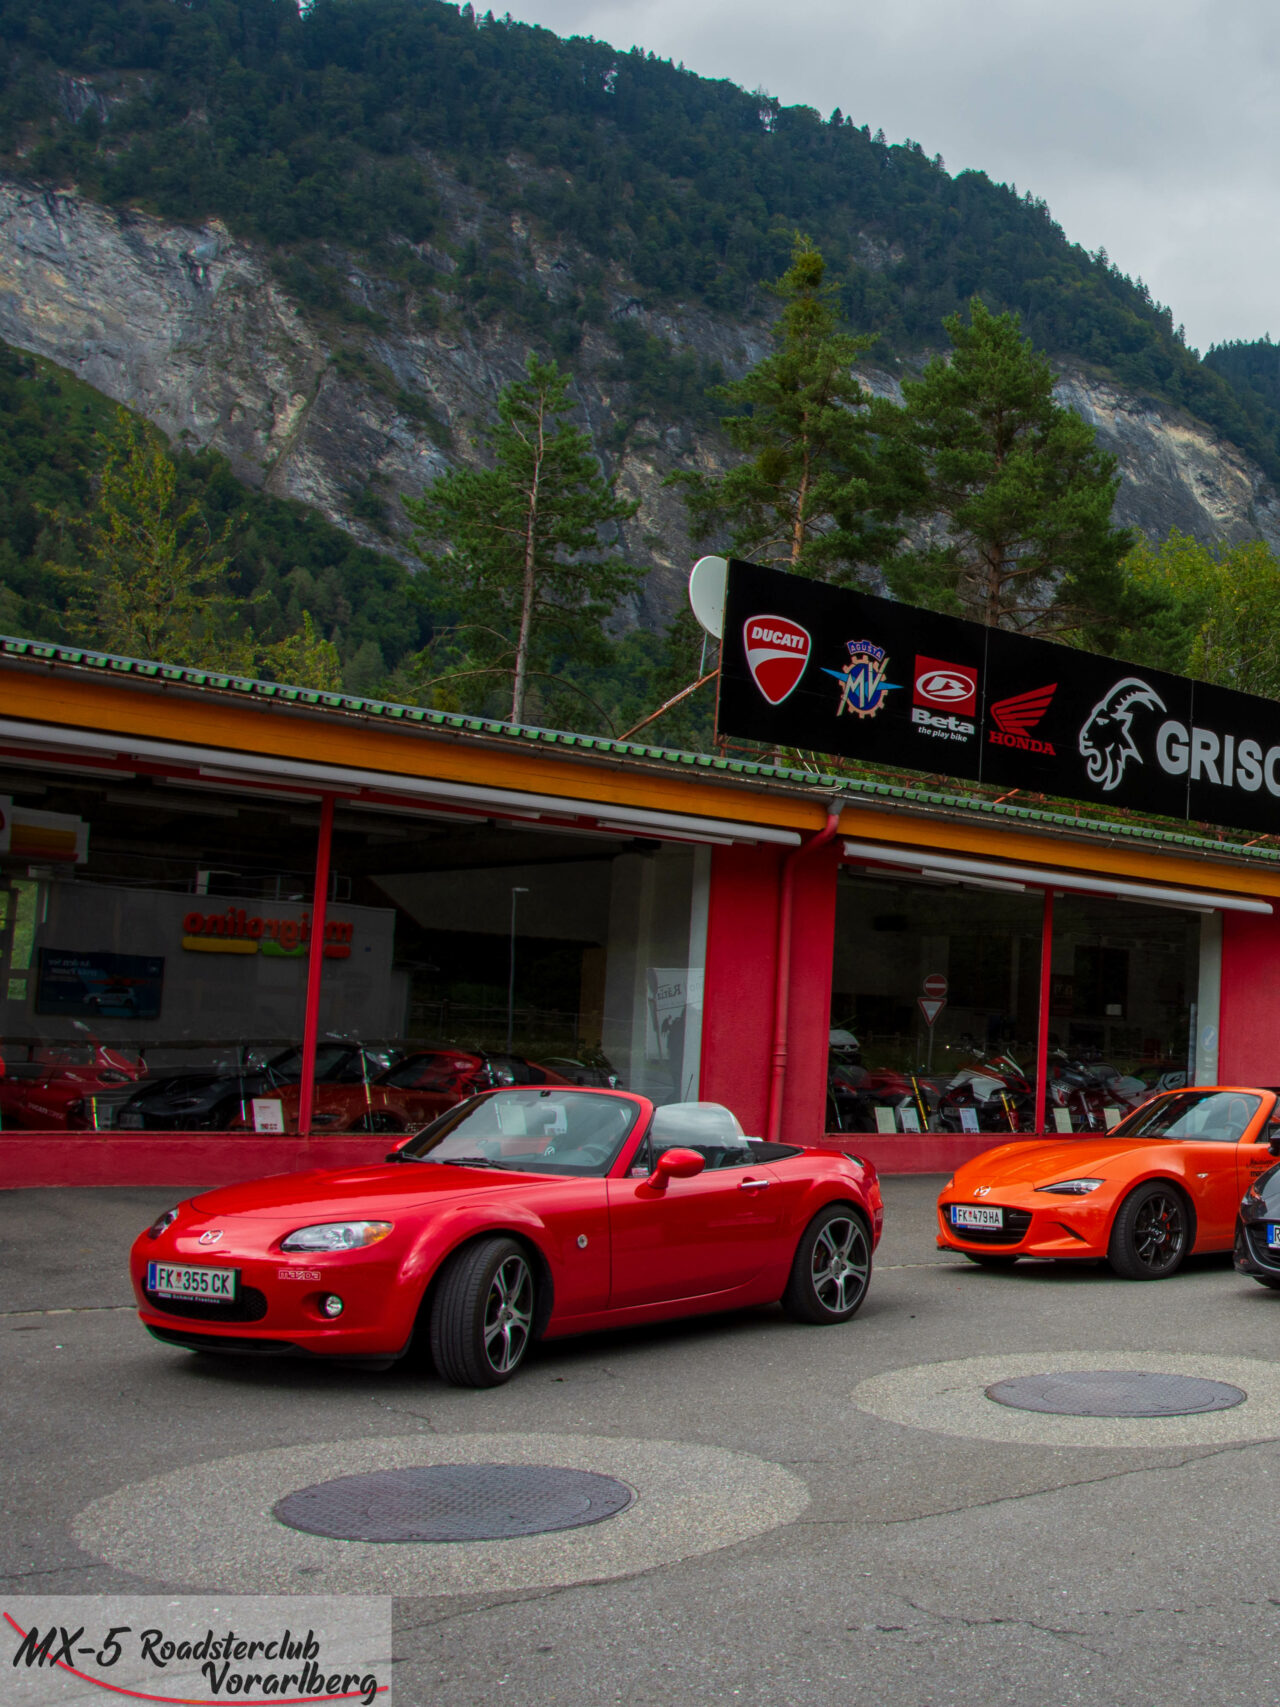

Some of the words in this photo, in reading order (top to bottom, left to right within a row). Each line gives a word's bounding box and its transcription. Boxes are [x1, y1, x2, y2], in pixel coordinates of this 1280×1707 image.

[751, 626, 805, 650] DUCATI
[850, 642, 882, 658] AGUSTA
[911, 707, 975, 735] Beta
[917, 726, 933, 735] the
[932, 729, 950, 740] play
[950, 732, 968, 743] bike
[988, 730, 1056, 756] HONDA
[957, 1208, 968, 1221] FK
[158, 1268, 175, 1289] FK
[183, 1270, 209, 1292] 355
[212, 1273, 231, 1294] CK
[278, 1269, 321, 1281] mazda
